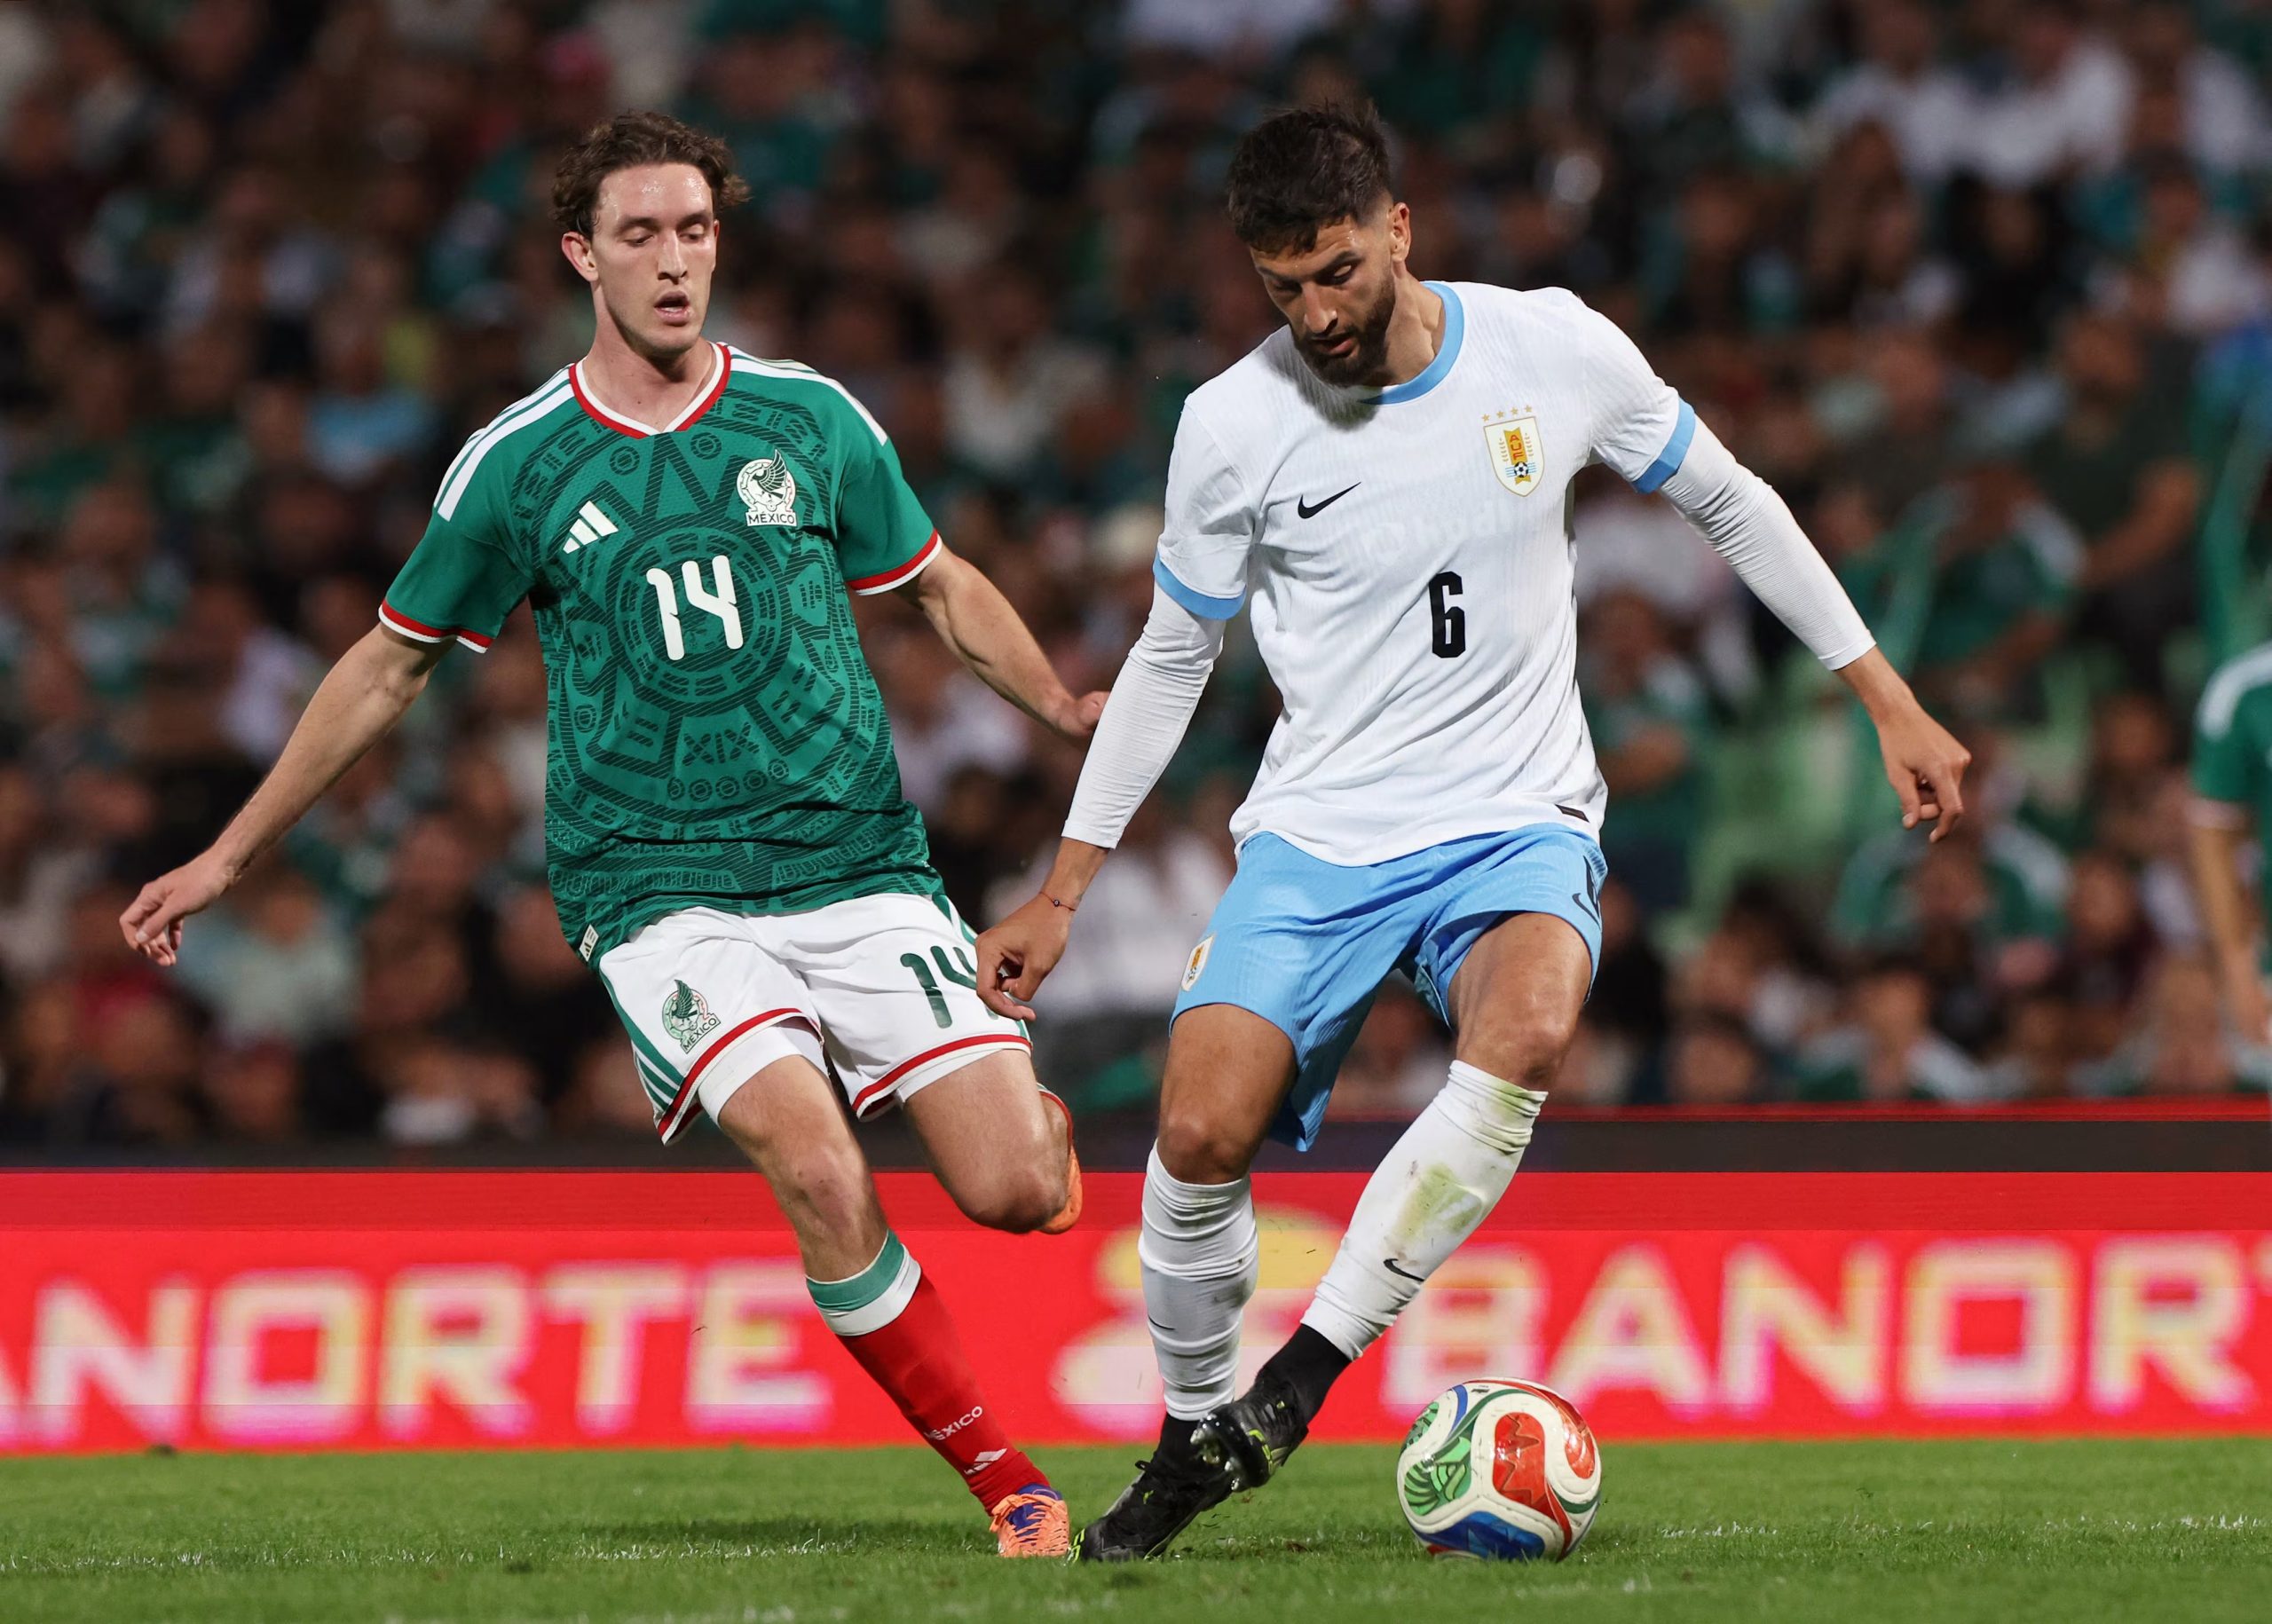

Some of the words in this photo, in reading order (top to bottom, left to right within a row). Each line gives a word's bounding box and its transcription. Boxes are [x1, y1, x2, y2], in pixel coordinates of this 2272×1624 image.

[1509, 434, 1525, 461] AUF
[748, 511, 795, 524] MÉXICO
[645, 555, 744, 661] 14
[1429, 571, 1466, 658] 6
[0, 1257, 831, 1443] NORTE
[1384, 1235, 2272, 1419] BANOR
